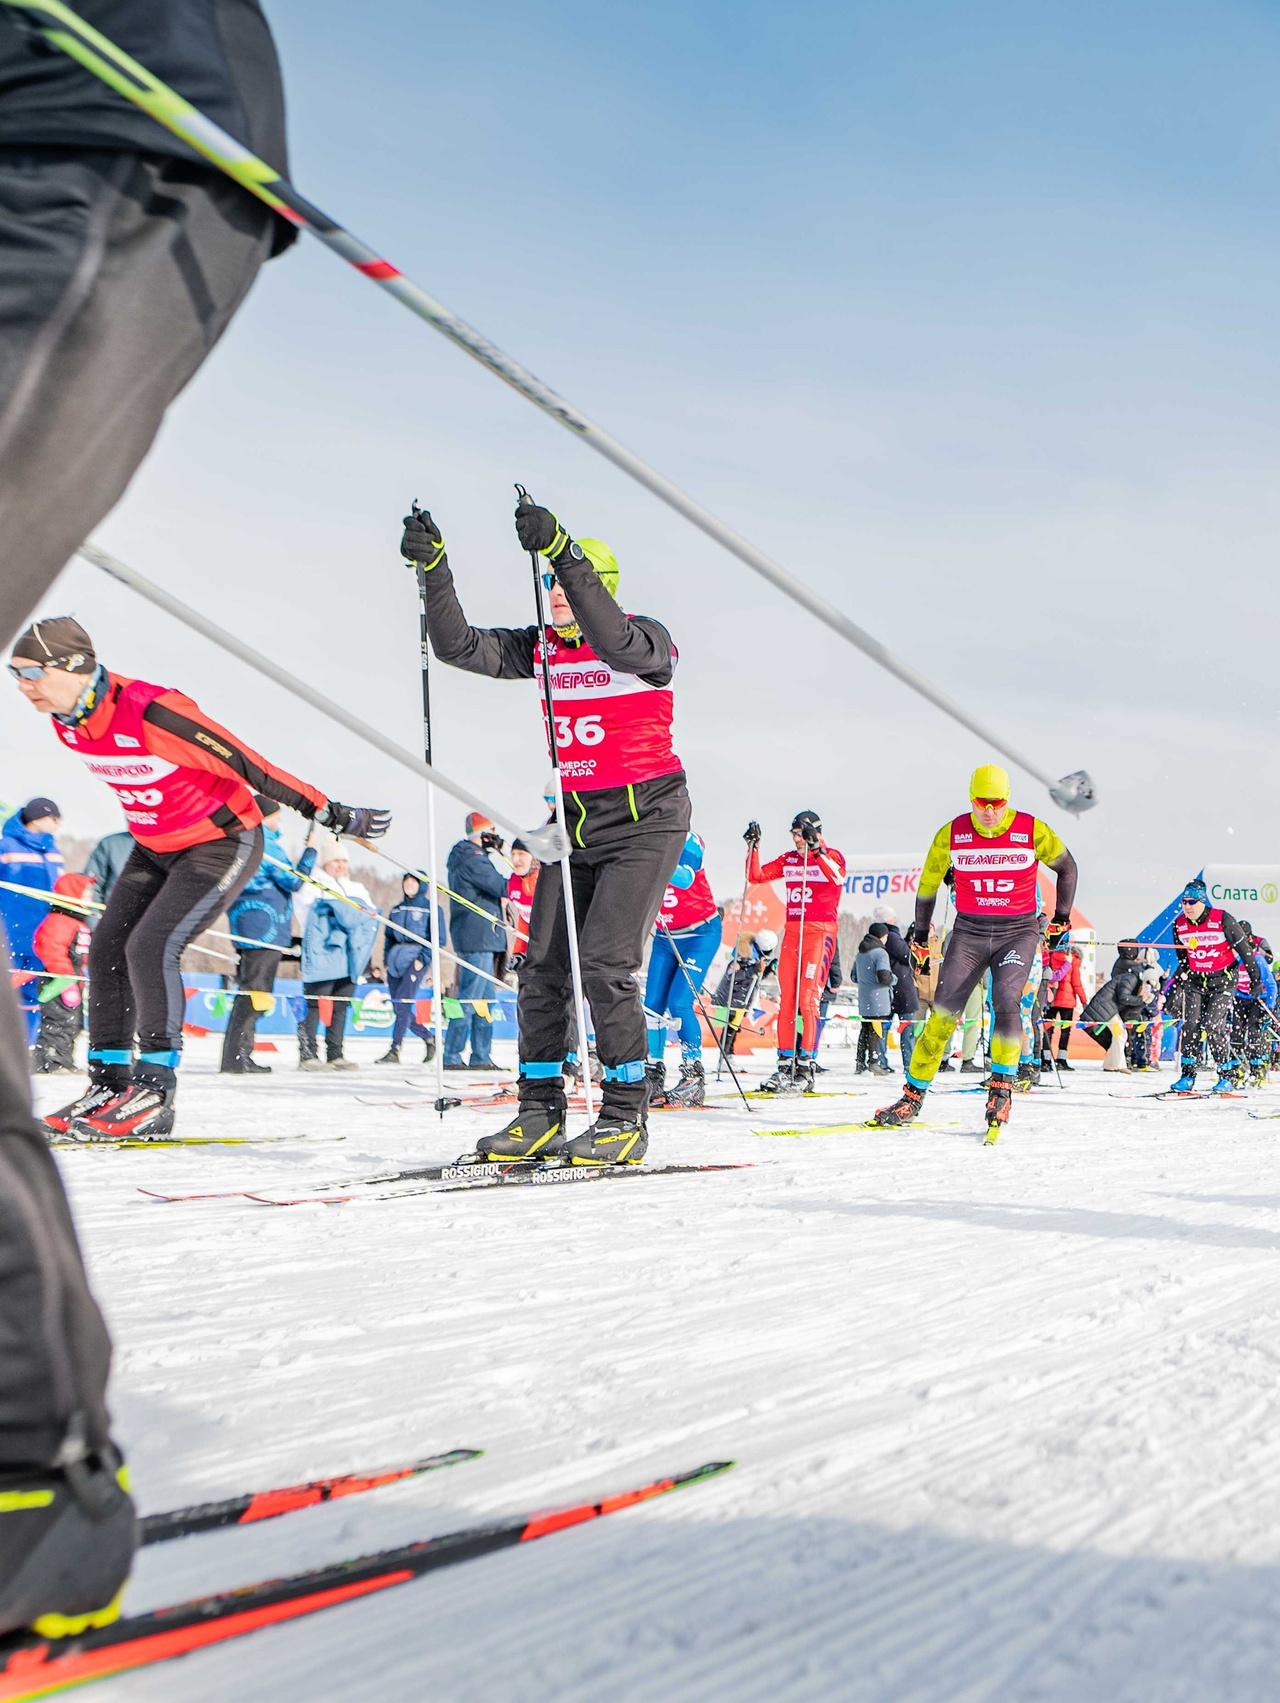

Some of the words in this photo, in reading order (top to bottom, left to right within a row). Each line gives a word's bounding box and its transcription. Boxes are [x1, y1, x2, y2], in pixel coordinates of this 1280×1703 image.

[557, 759, 597, 771] ЕМЕРСО
[970, 879, 1015, 893] 115
[1211, 884, 1258, 901] Слата
[787, 887, 813, 903] 162
